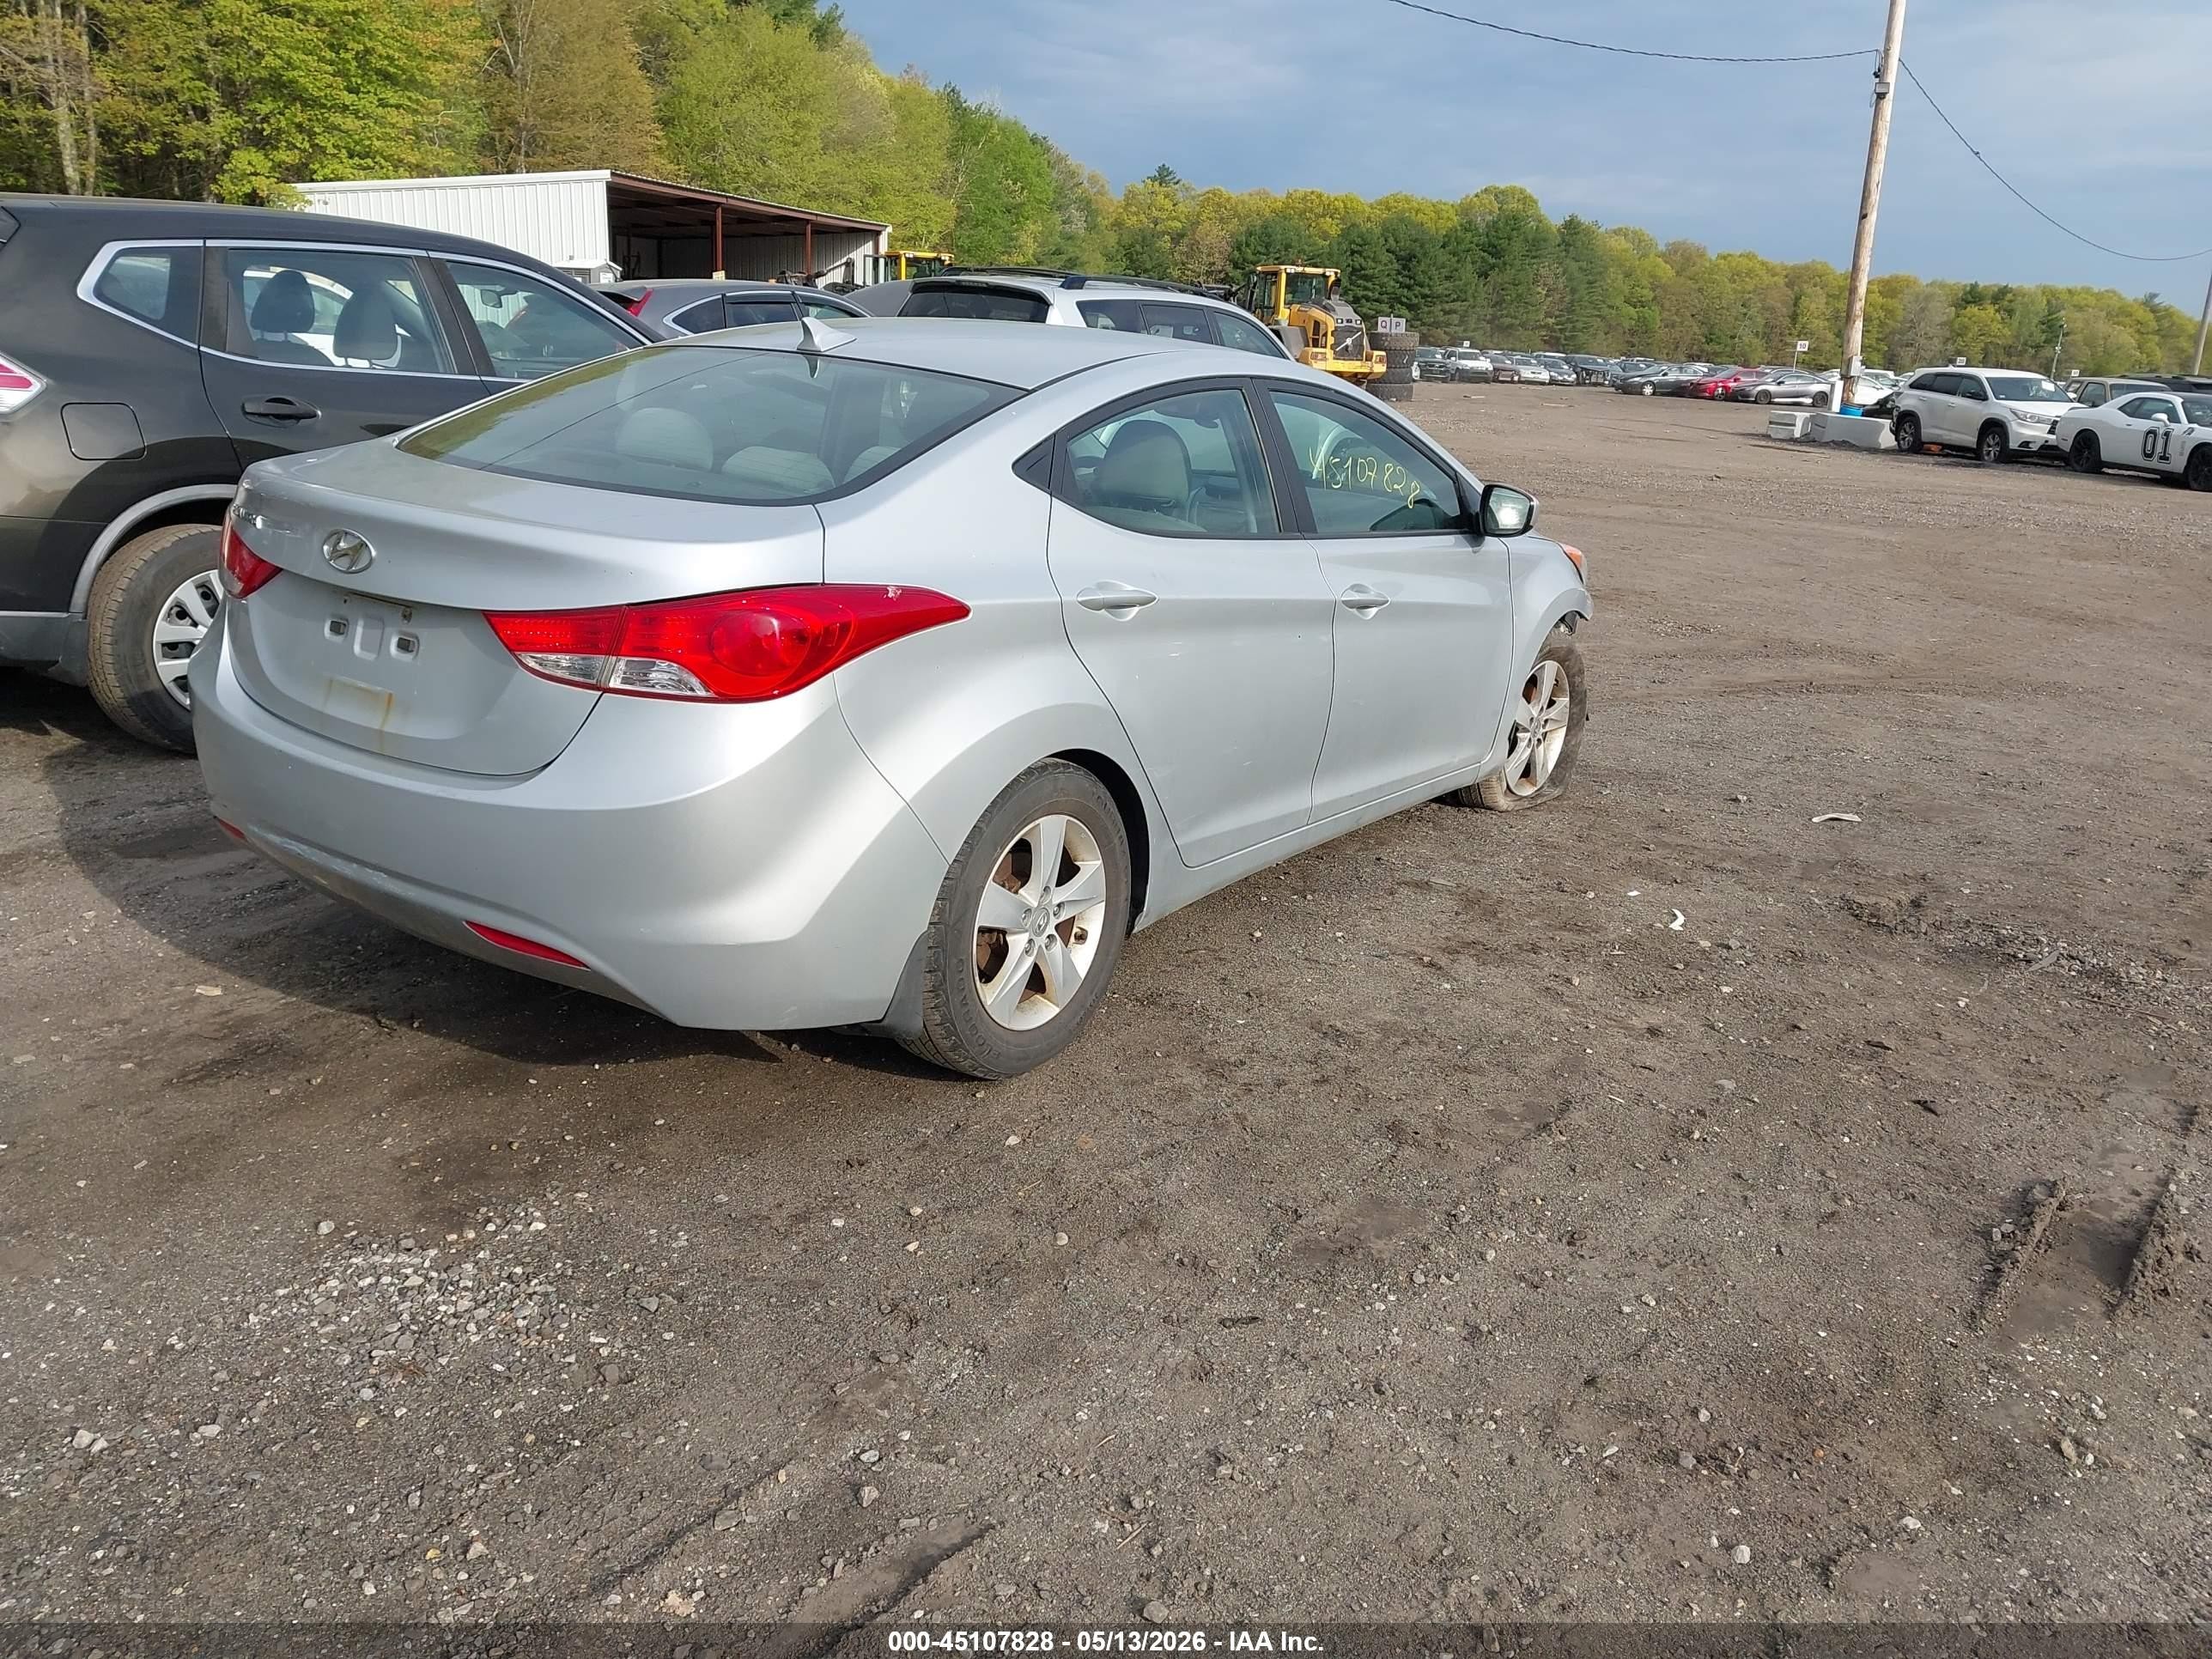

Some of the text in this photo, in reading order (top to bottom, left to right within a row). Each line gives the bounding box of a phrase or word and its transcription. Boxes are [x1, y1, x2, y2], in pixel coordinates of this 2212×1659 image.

[1380, 319, 1388, 330] Q
[1395, 321, 1401, 331] P
[2141, 426, 2174, 465] 01
[1309, 447, 1419, 508] 45107828
